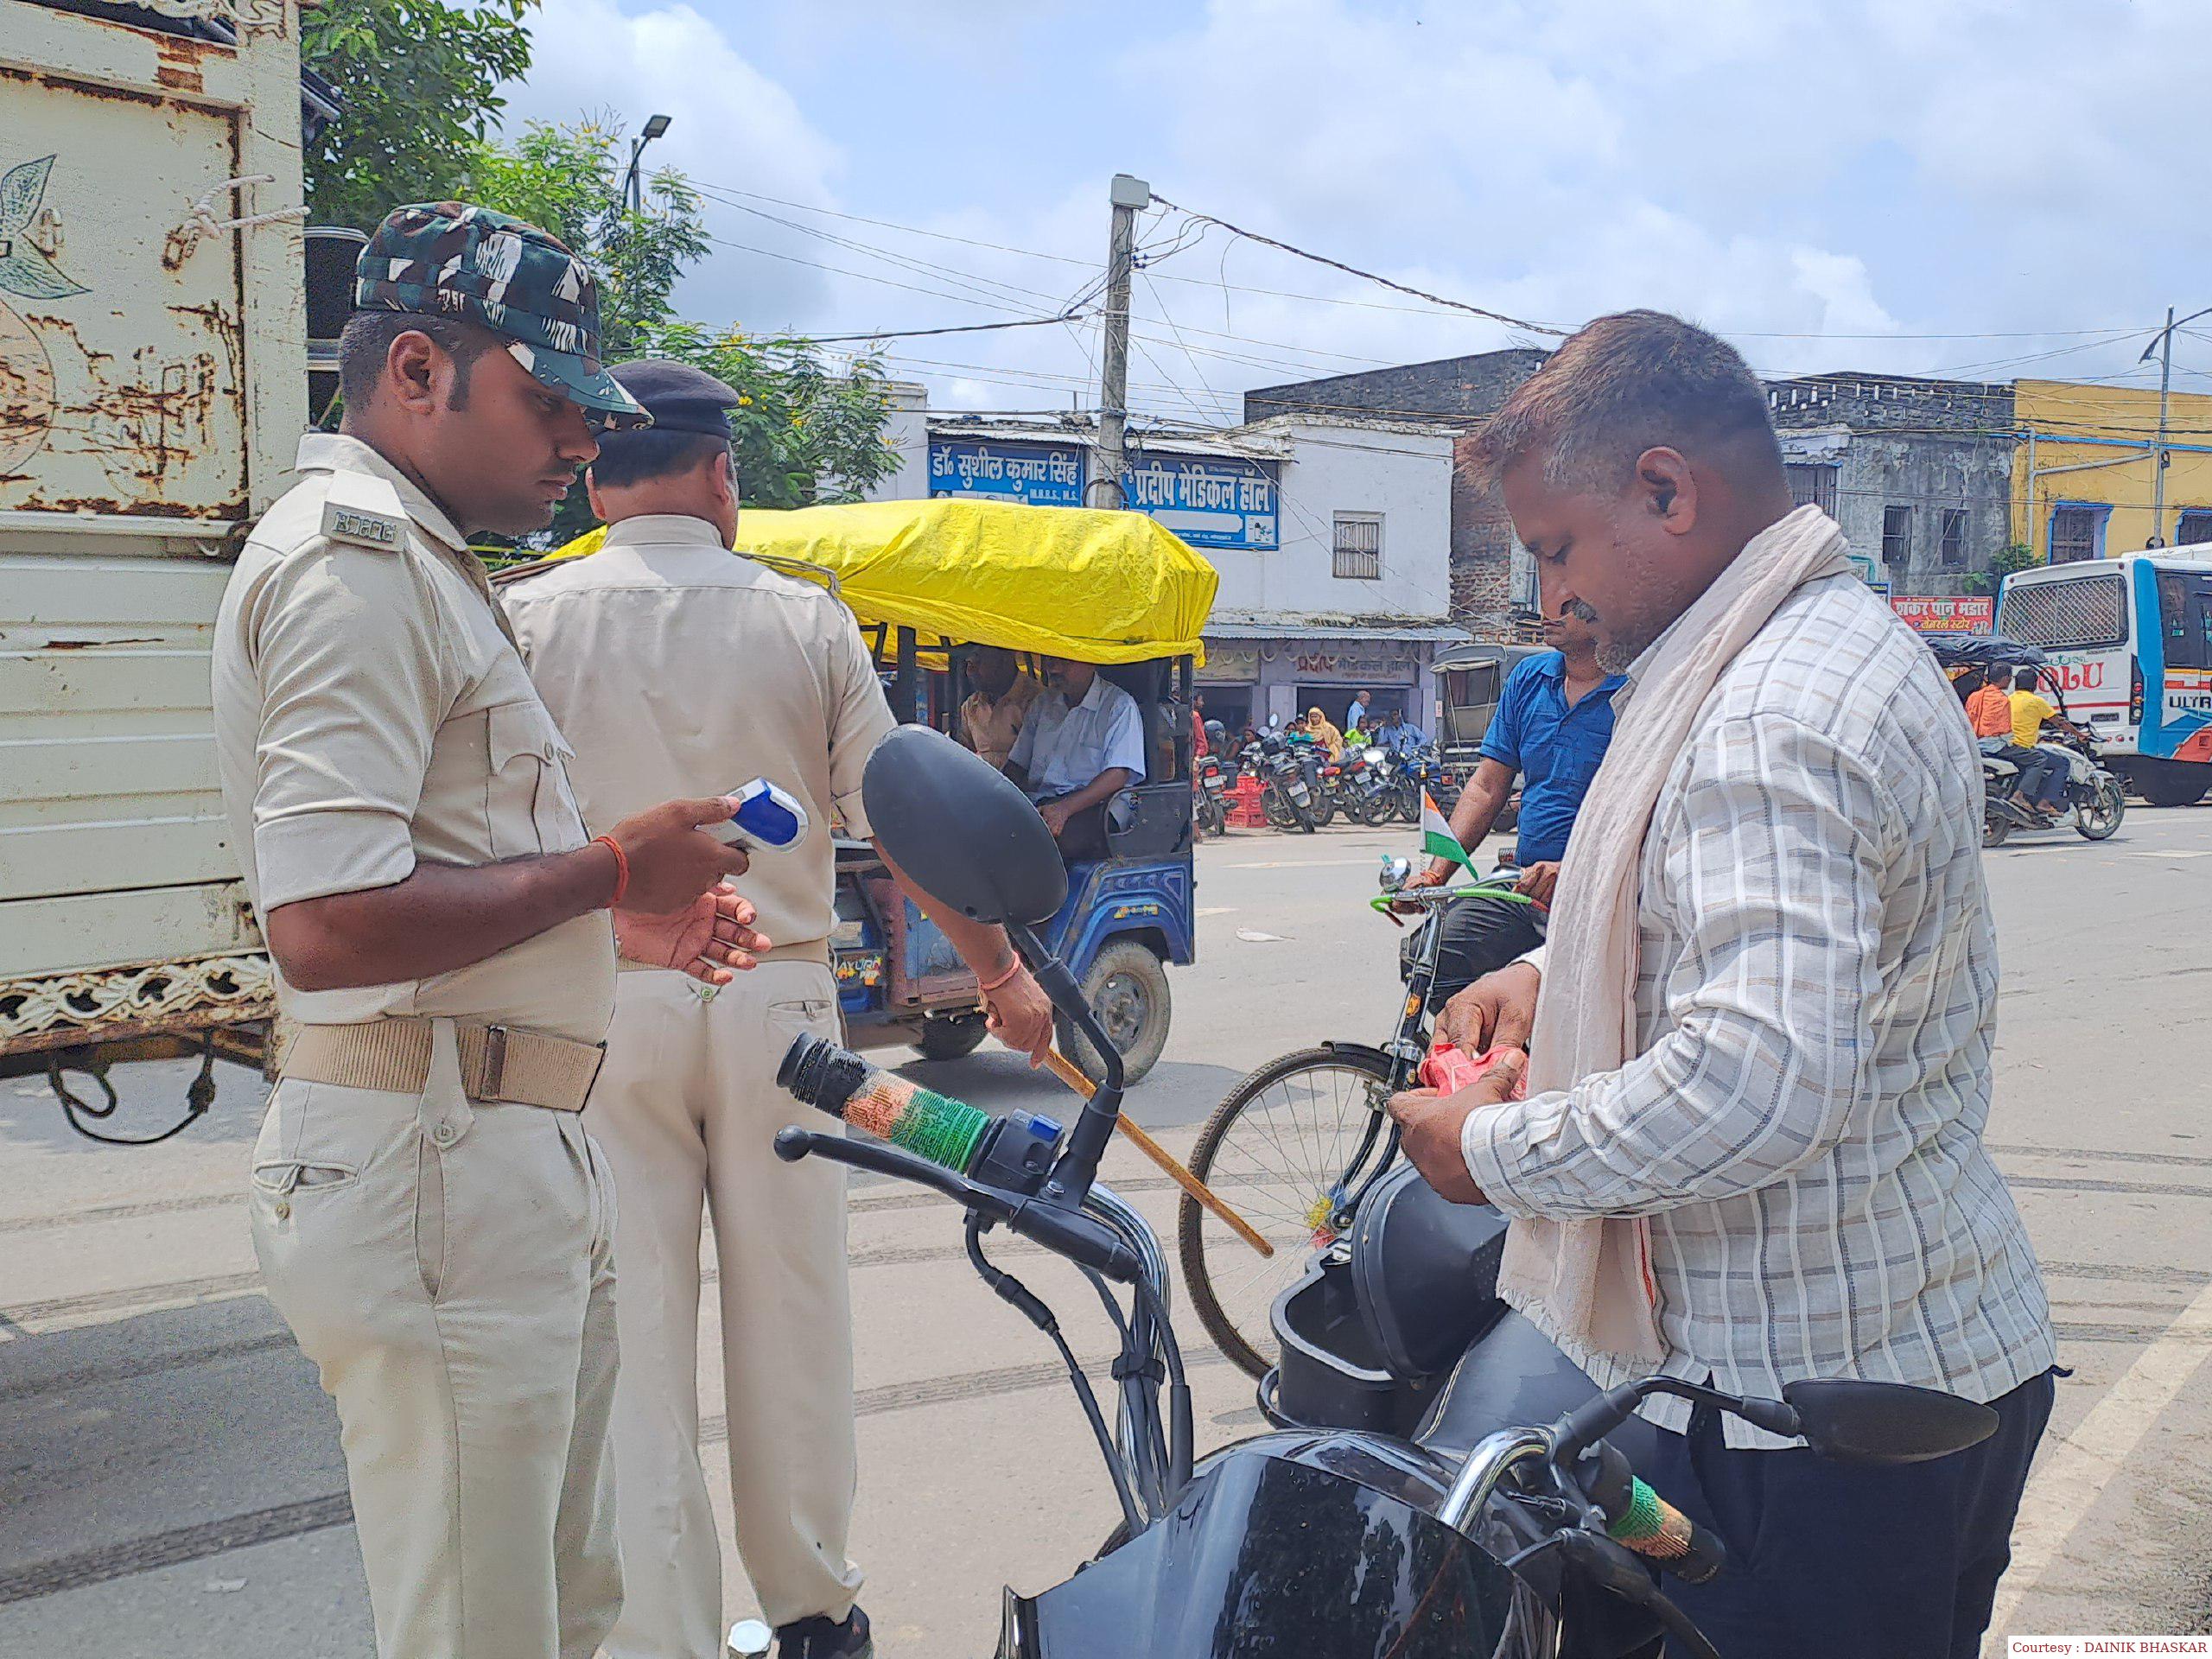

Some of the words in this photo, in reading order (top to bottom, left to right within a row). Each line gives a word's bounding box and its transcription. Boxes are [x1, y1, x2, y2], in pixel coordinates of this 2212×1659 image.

[957, 446, 1004, 489] सुशील
[1006, 458, 1048, 493] कुमार
[1048, 450, 1079, 486] सिंह
[1135, 460, 1177, 506] प्रदीप
[1178, 461, 1237, 510] मेडिकल
[1238, 467, 1270, 512] हॉल
[1929, 601, 1958, 615] पान
